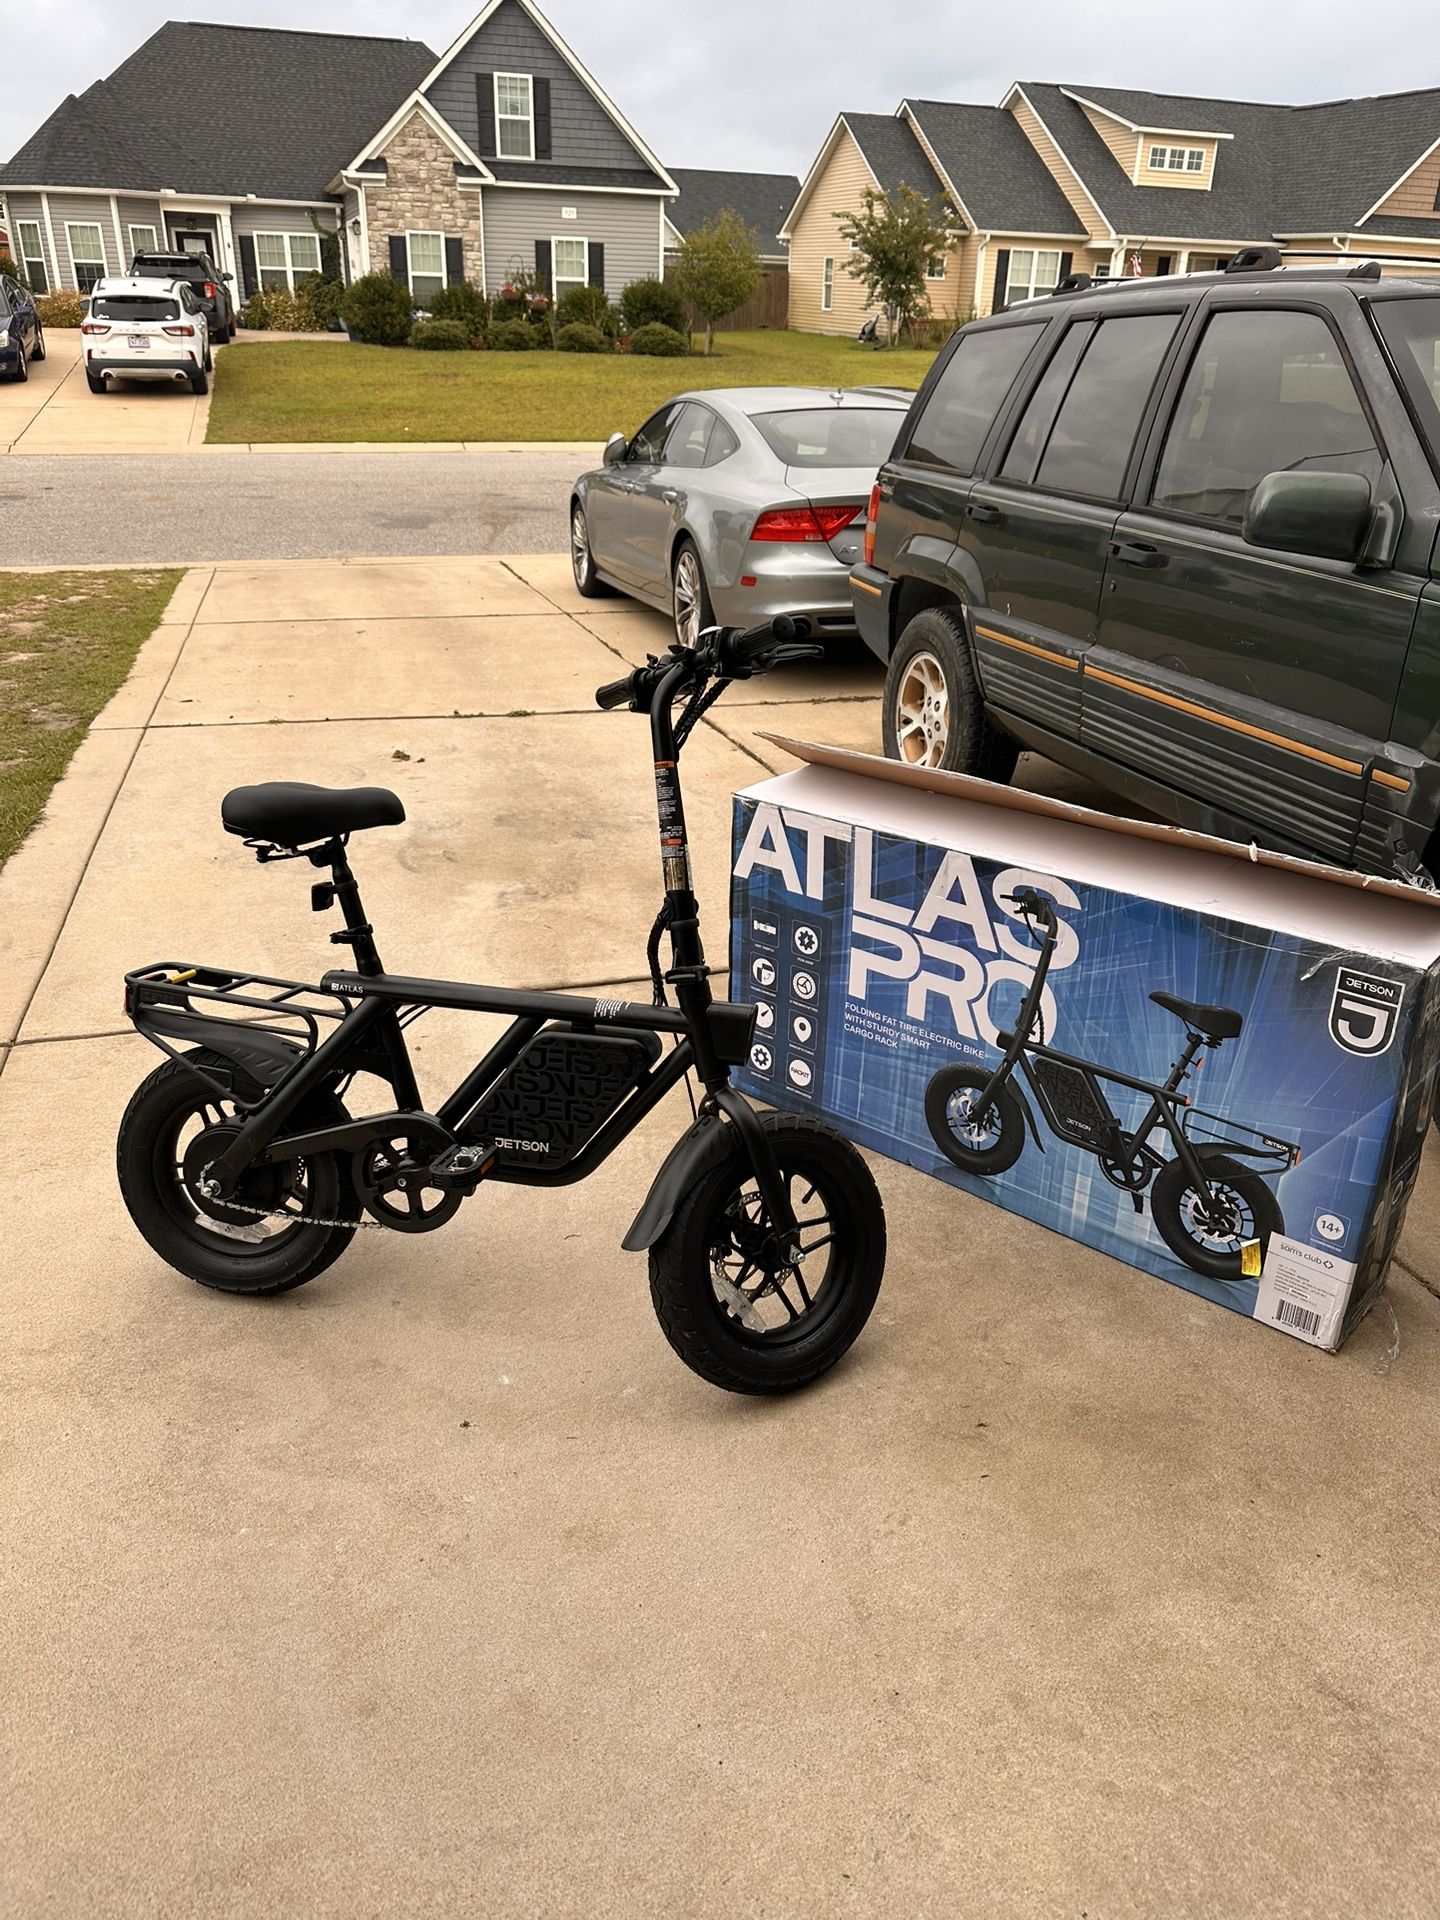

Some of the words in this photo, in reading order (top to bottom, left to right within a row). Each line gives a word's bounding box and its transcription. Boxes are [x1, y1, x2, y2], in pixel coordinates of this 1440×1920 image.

[839, 543, 859, 554] A7
[732, 802, 1081, 970] ATLAS
[339, 984, 364, 993] ATLAS
[849, 915, 1058, 1057] PRO
[1345, 977, 1394, 997] JETSON
[843, 1023, 874, 1040] CARGO
[874, 1034, 898, 1049] RACK
[844, 1012, 866, 1026] WITH
[866, 1020, 900, 1038] STURDY
[900, 1033, 932, 1050] SMART
[845, 1002, 881, 1020] FOLDING
[882, 1014, 898, 1026] FAT
[898, 1020, 918, 1034] TIRE
[919, 1028, 962, 1050] ELECTRIC
[963, 1045, 985, 1059] BIKE
[1066, 1117, 1092, 1131] JETSON
[494, 1137, 549, 1153] JETSON
[1264, 1139, 1289, 1151] JETSON
[1321, 1220, 1341, 1234] 14+
[1280, 1243, 1303, 1257] sam's
[1303, 1251, 1323, 1264] club
